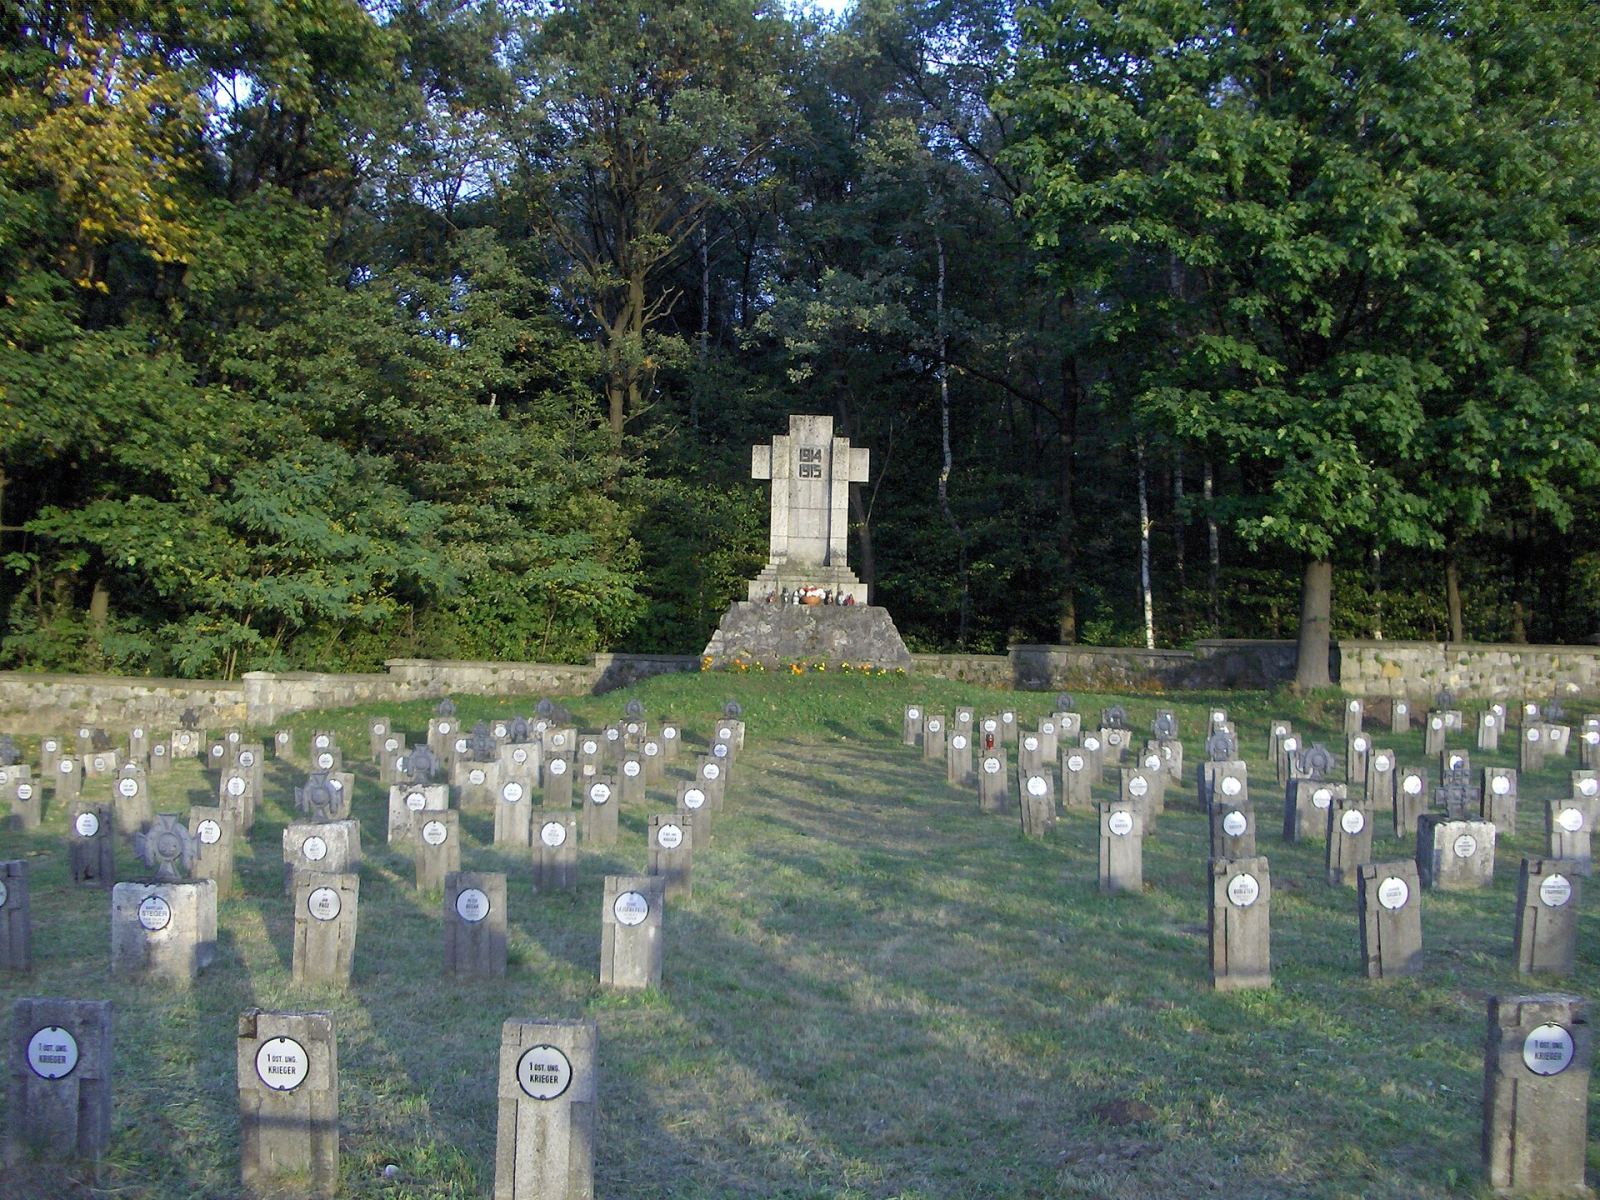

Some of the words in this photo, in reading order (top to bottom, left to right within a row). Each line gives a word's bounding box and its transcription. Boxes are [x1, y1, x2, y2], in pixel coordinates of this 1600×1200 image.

[800, 448, 821, 462] 1914
[799, 463, 821, 478] 1915
[268, 1065, 296, 1075] KRIEGER
[529, 1074, 559, 1084] KRIEGER
